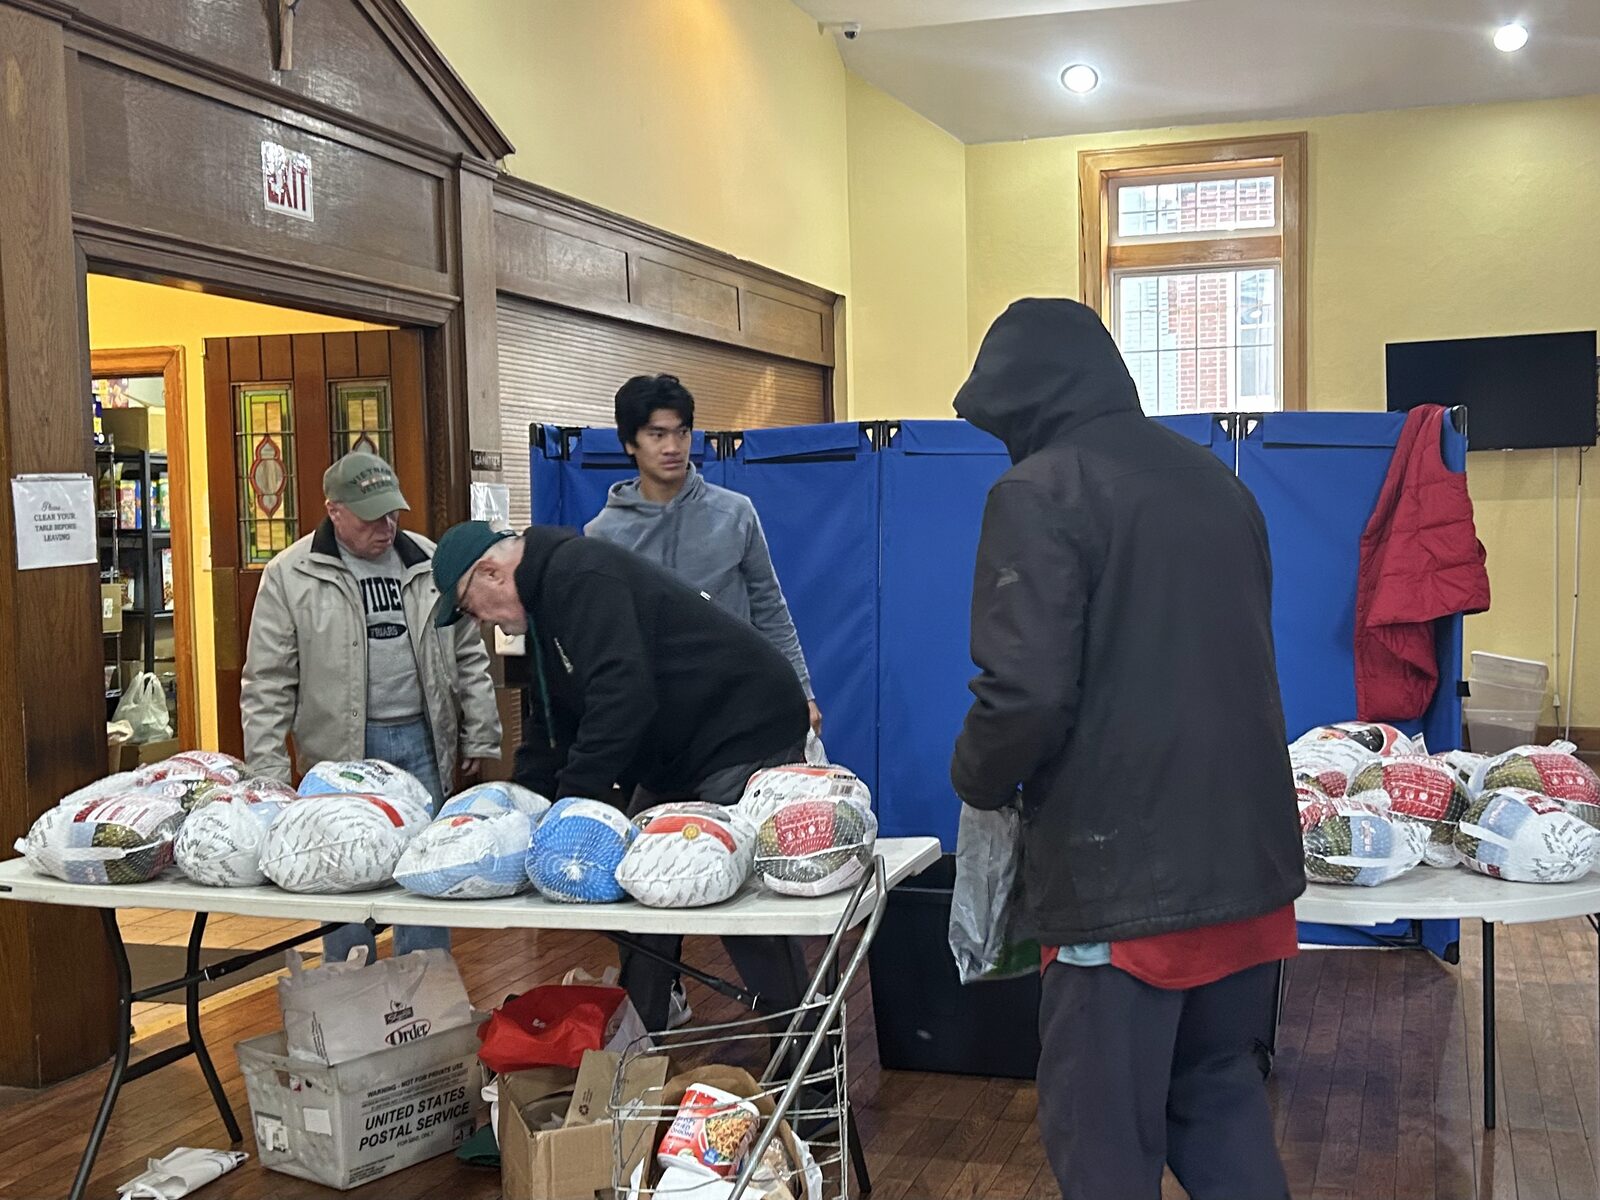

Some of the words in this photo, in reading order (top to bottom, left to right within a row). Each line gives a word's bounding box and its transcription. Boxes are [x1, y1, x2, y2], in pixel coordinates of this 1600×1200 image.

[267, 159, 308, 211] EXIT
[34, 513, 56, 522] CLEAR
[57, 512, 76, 520] YOUR
[35, 524, 53, 532] TABLE
[54, 523, 76, 531] BEFORE
[44, 533, 70, 542] LEAVING
[365, 1104, 415, 1132] UNITED
[417, 1086, 466, 1115] STATES
[359, 1122, 412, 1152] POSTAL
[416, 1101, 470, 1131] SERVICE
